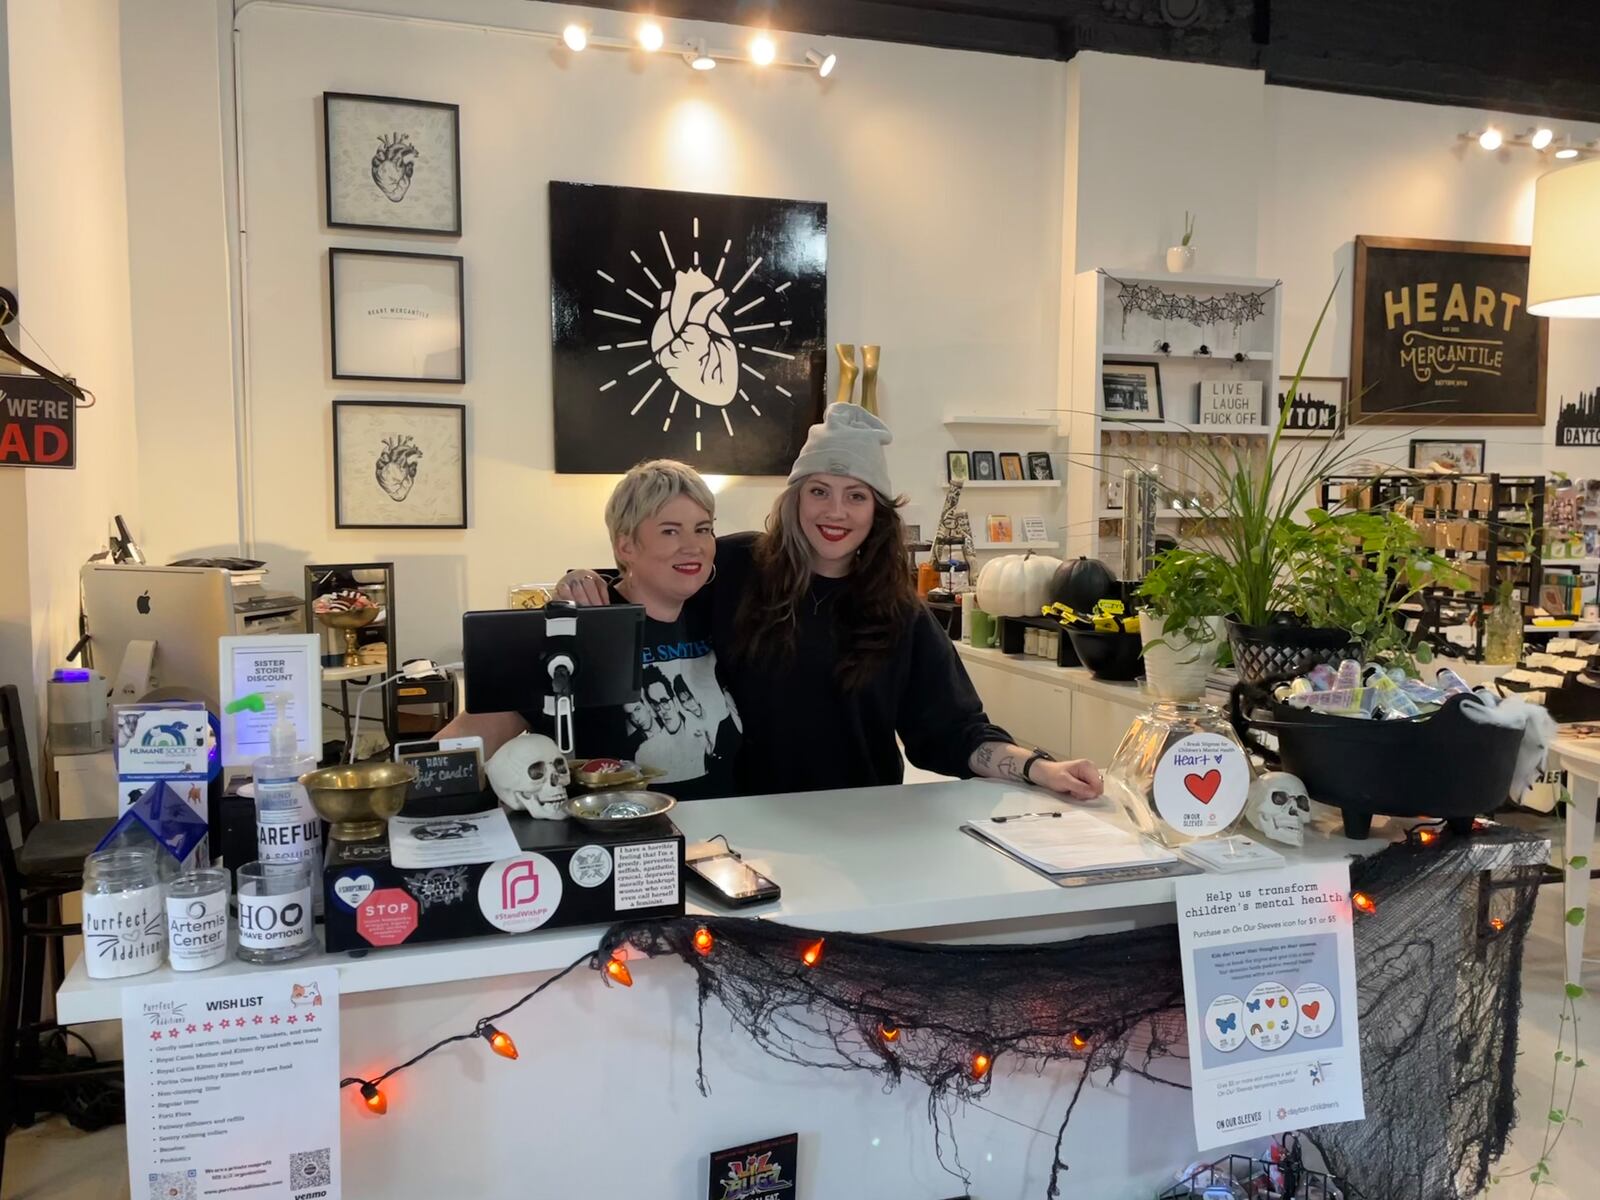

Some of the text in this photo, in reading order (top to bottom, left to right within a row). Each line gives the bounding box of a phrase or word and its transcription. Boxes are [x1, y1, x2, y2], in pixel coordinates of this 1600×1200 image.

[1384, 282, 1521, 332] HEART
[1400, 345, 1504, 382] MERCANTILE
[1213, 383, 1243, 395] LIVE
[7, 398, 69, 420] WE'RE
[1213, 398, 1249, 410] LAUGH
[1204, 412, 1257, 424] FUCK OFF
[254, 659, 286, 667] SISTER
[247, 674, 294, 682] DISCOUNT
[130, 747, 164, 755] HUMANE
[1174, 754, 1210, 766] Heart
[1206, 891, 1232, 902] Help
[1258, 883, 1318, 897] transform
[365, 903, 409, 916] STOP
[1185, 893, 1342, 918] children's mental health
[87, 908, 147, 931] Purrfect
[495, 907, 547, 920] #StandWithPP
[170, 915, 225, 933] Artemis
[1193, 928, 1221, 939] Purchase
[1231, 925, 1242, 933] On
[1243, 923, 1256, 932] Our
[1257, 921, 1281, 931] Sleeves
[1282, 918, 1296, 927] icon
[1297, 917, 1307, 926] for
[1309, 916, 1317, 925] $1
[1328, 915, 1336, 924] $5
[173, 930, 222, 946] Center
[244, 927, 304, 940] HAVE OPTIONS
[143, 1000, 174, 1011] Purrfect
[206, 996, 263, 1012] WISH LIST
[1288, 1101, 1339, 1116] dayton children's
[1216, 1119, 1225, 1130] ON
[1225, 1116, 1237, 1127] OUR
[1237, 1111, 1262, 1125] SLEEVES
[294, 1190, 327, 1200] venmo
